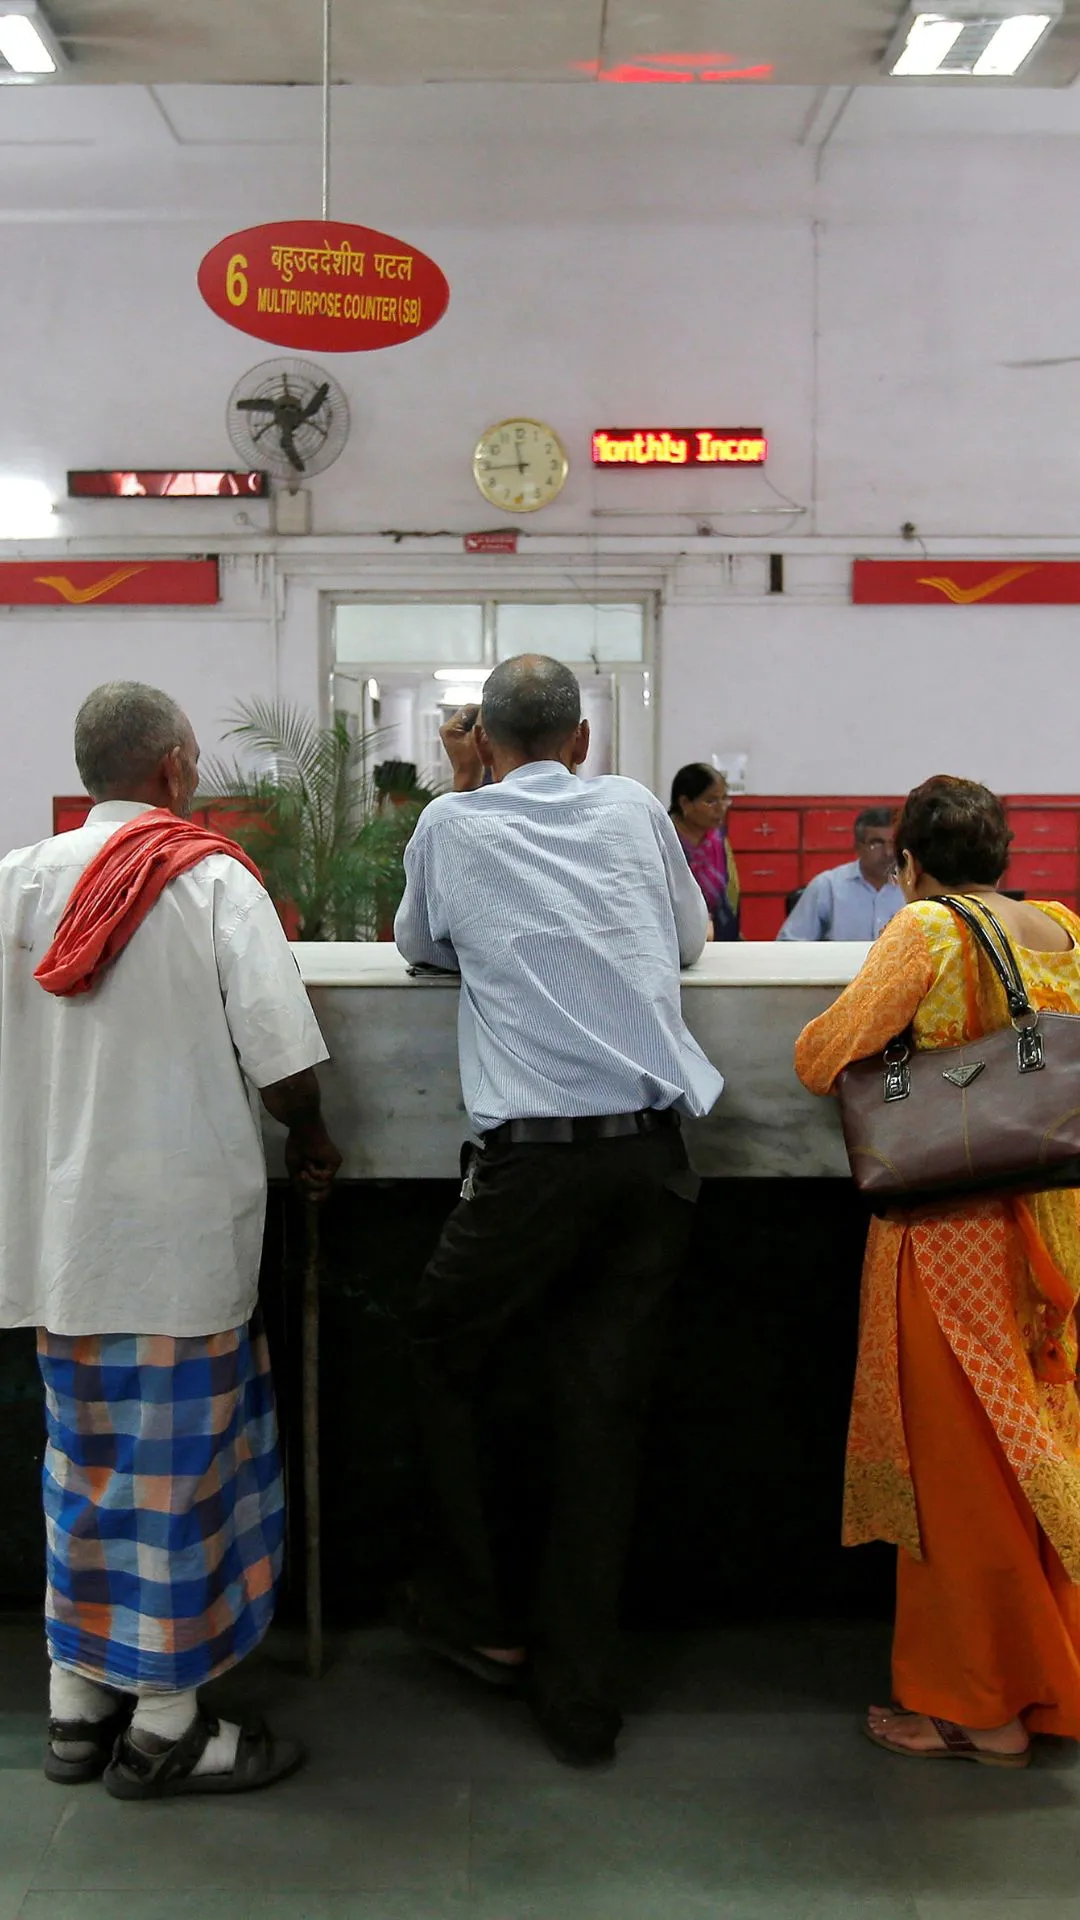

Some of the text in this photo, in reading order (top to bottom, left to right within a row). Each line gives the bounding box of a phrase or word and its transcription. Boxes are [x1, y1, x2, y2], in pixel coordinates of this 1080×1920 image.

[373, 253, 413, 281] पटल
[226, 254, 248, 306] 6
[257, 287, 342, 318] MULTIPURPOSE
[515, 428, 525, 439] 12
[544, 443, 552, 454] 2
[550, 459, 559, 470] 3
[545, 476, 552, 486] 4
